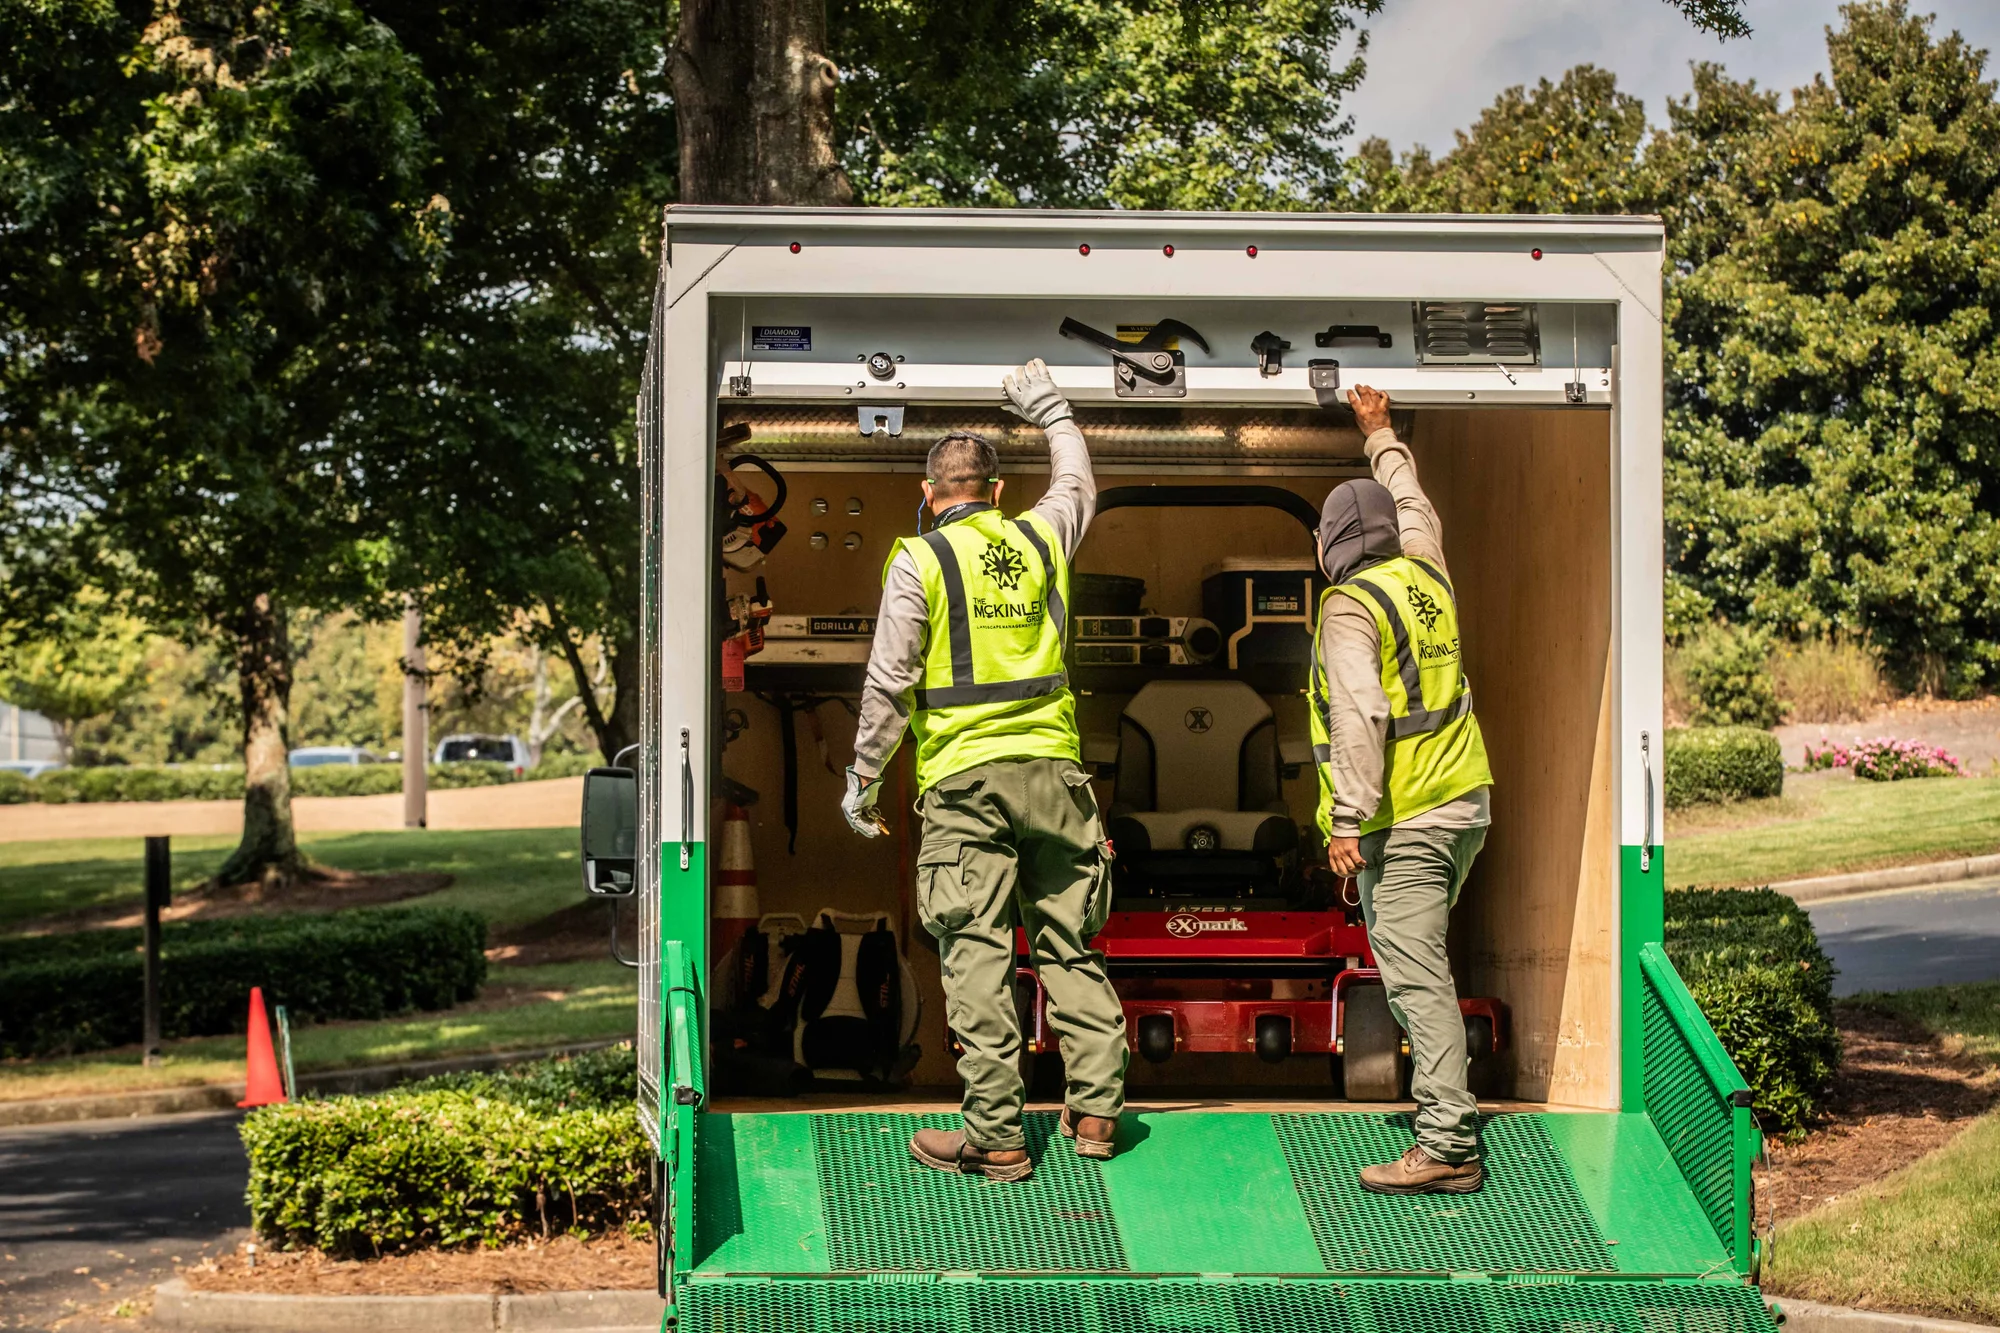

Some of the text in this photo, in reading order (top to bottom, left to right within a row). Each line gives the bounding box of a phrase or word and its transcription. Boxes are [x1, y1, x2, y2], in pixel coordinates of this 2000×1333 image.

[763, 328, 800, 336] DIAMOND
[973, 597, 987, 605] THE
[813, 622, 855, 631] GORILLA
